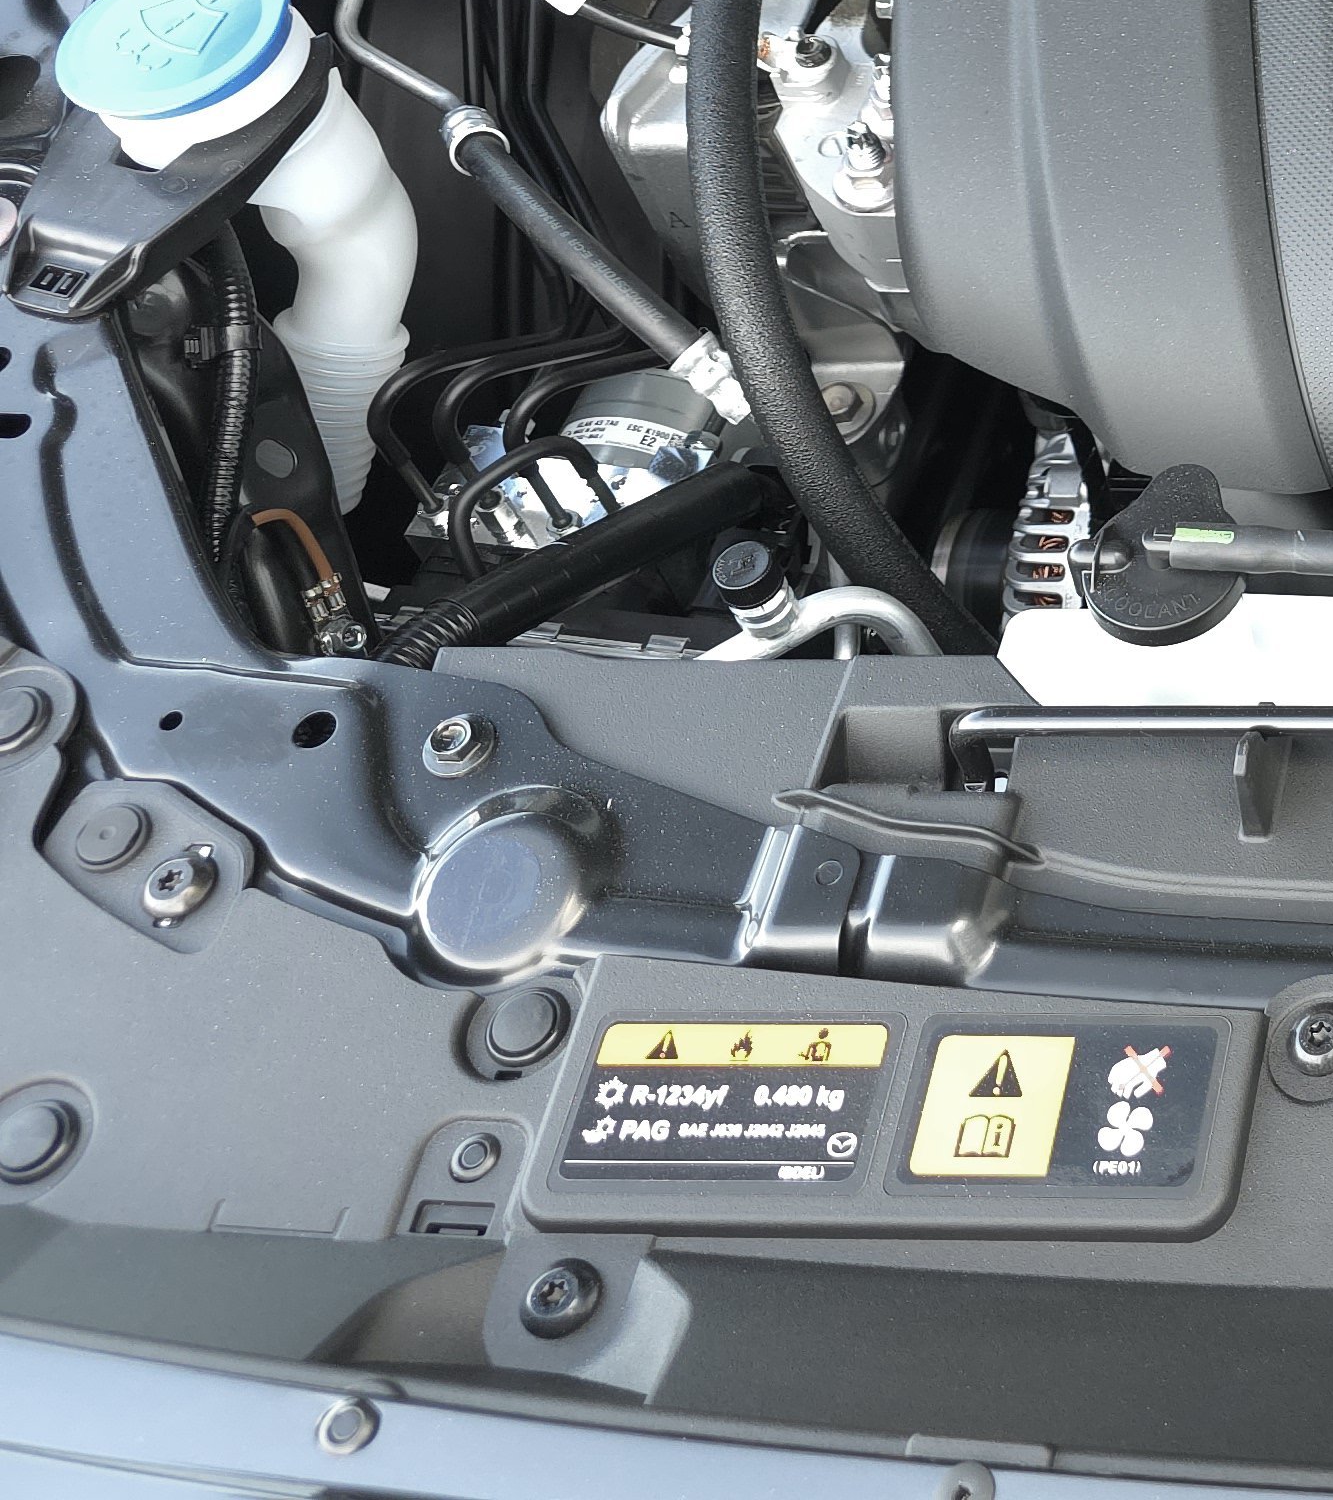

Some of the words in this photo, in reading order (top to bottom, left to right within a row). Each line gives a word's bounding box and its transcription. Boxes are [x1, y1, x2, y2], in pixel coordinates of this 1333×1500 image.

[626, 423, 642, 433] ESC
[639, 435, 657, 448] E2
[1105, 588, 1201, 619] COOLANT
[629, 1084, 730, 1111] R-1234yf
[815, 1084, 845, 1112] kg
[618, 1119, 671, 1141] PAG
[1092, 1160, 1141, 1175] (PE01)
